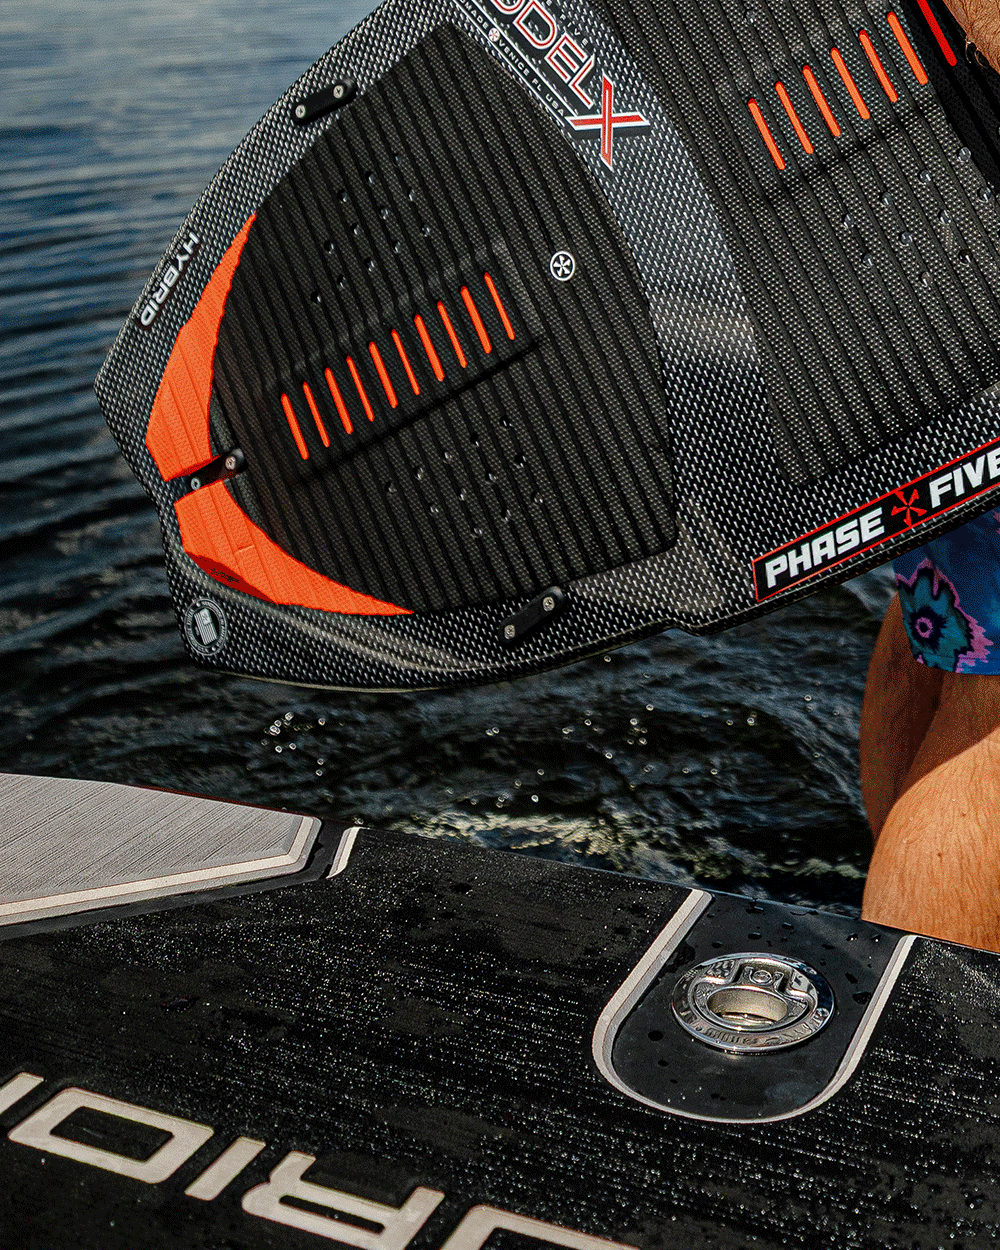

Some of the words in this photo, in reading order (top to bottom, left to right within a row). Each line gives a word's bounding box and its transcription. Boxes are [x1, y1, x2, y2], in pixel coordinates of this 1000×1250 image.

[559, 13, 589, 46] FIVE
[498, 39, 530, 77] VENICE
[531, 77, 542, 91] FL
[545, 93, 565, 117] USA
[564, 73, 651, 172] X
[140, 231, 200, 327] HYBRID
[764, 507, 885, 589] PHASE
